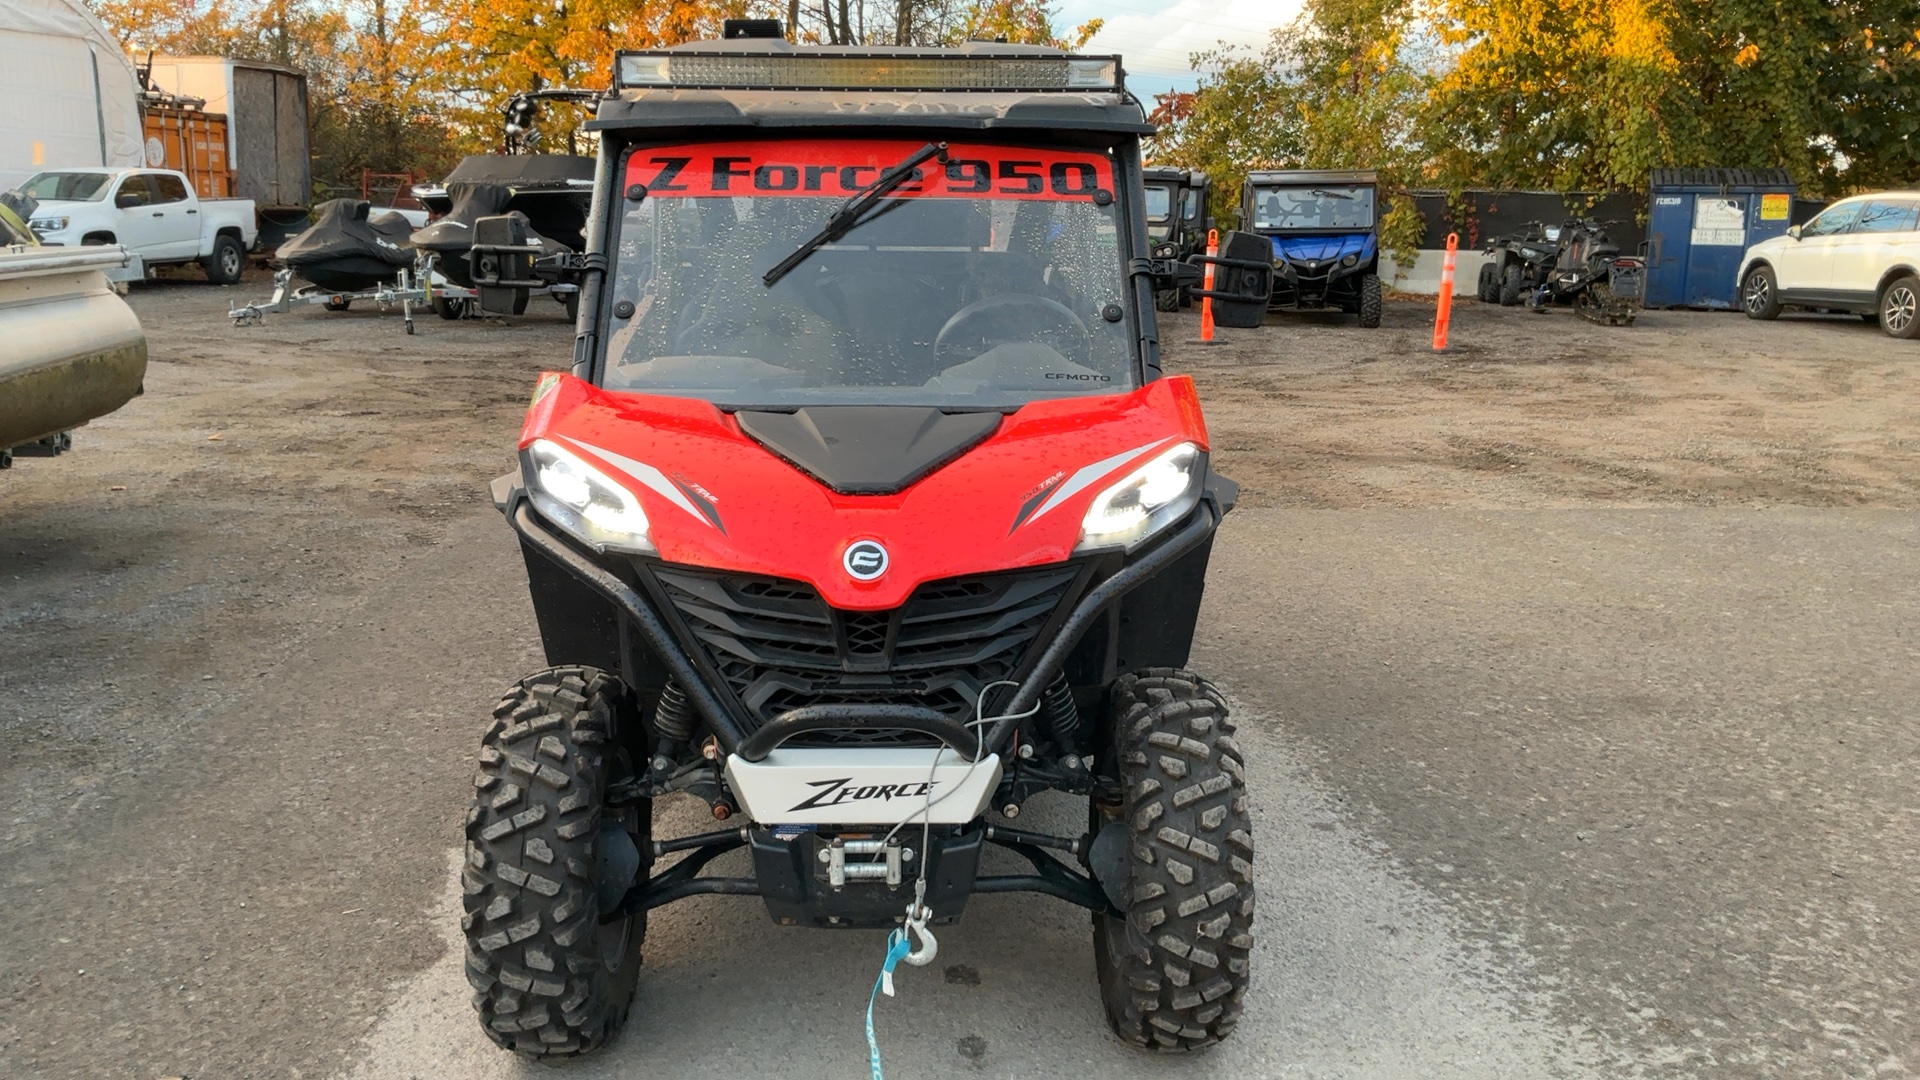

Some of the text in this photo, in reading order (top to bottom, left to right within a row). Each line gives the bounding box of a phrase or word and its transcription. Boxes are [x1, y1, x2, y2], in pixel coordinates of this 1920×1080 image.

[649, 157, 692, 190] Z
[945, 159, 1098, 195] 950
[1045, 373, 1111, 381] CFMOTO
[1038, 470, 1066, 489] TRAIL
